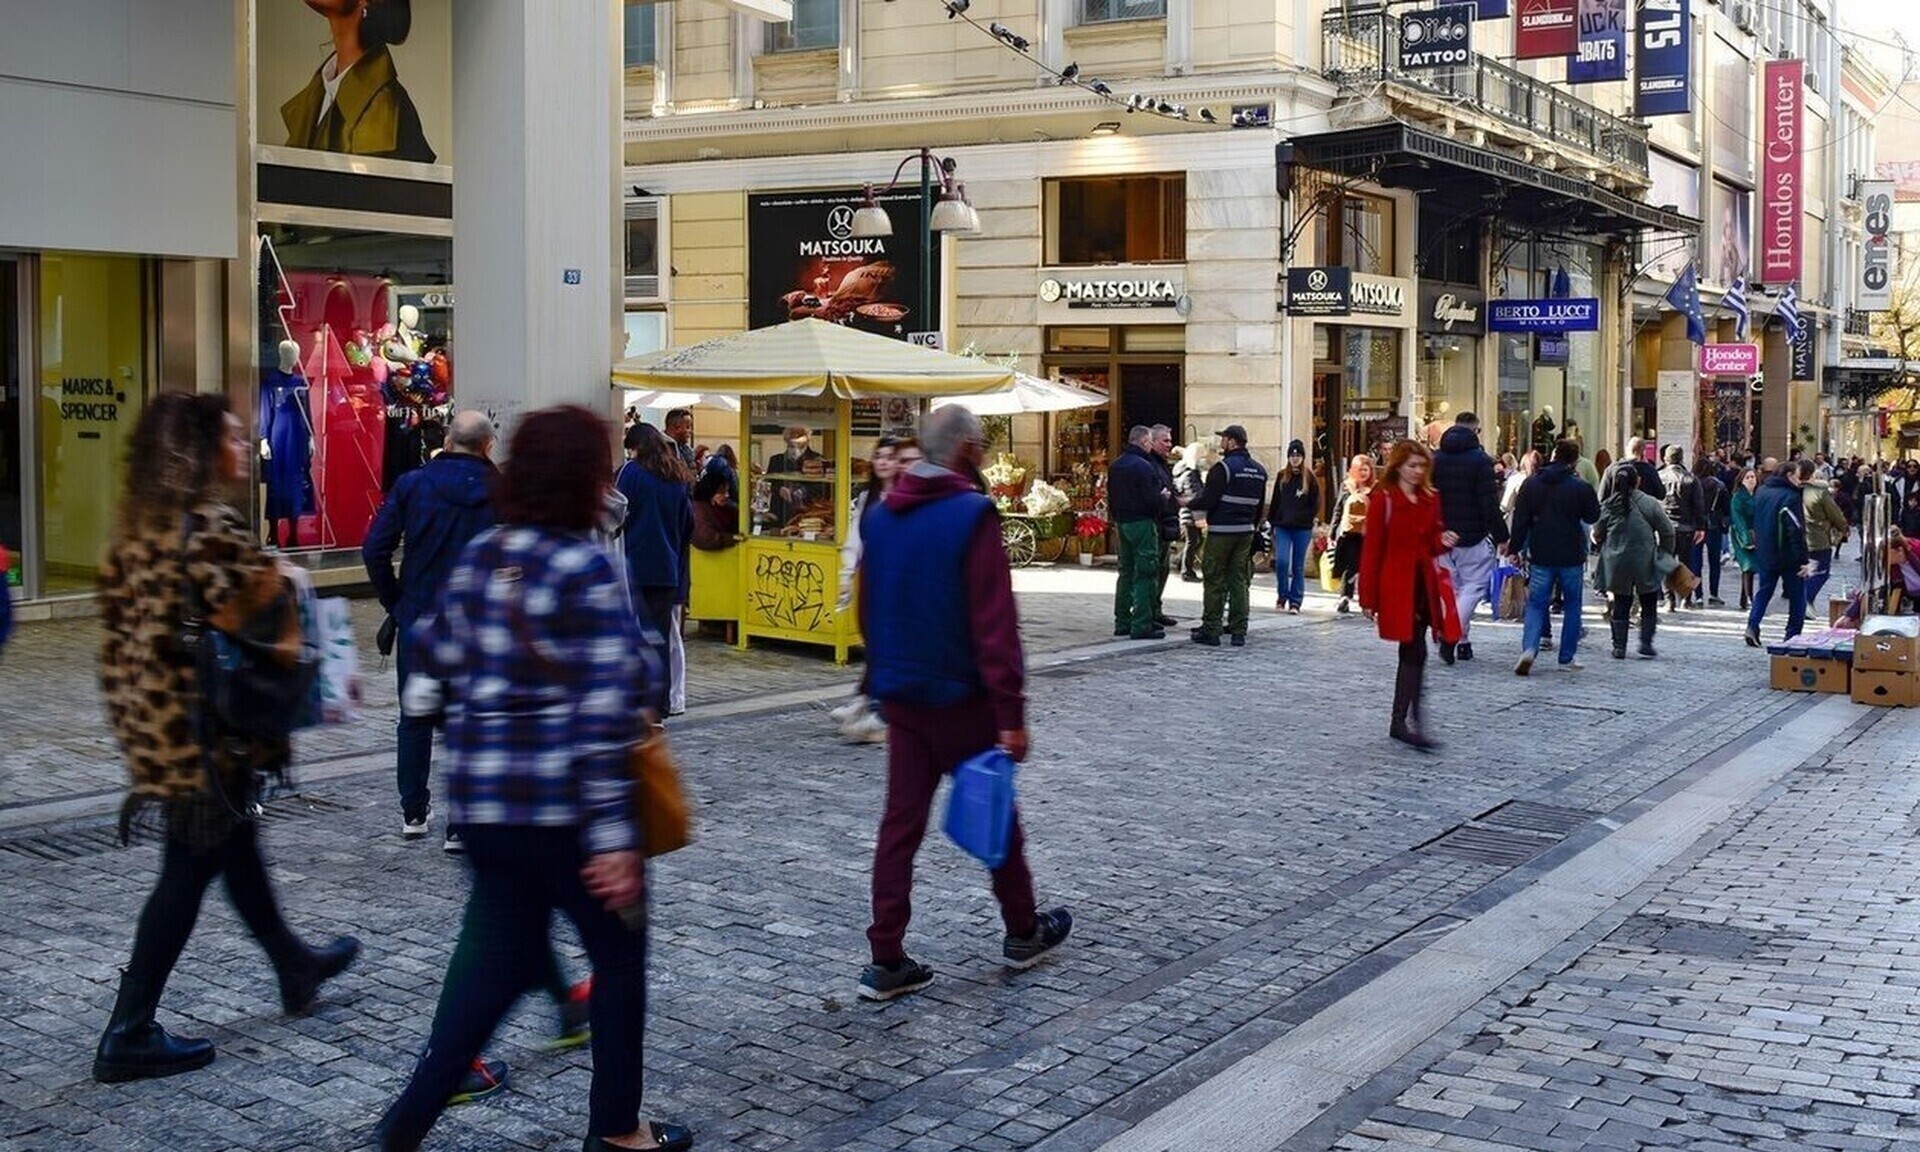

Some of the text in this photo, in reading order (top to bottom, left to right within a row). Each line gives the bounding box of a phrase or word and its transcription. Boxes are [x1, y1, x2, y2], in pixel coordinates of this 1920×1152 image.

[1402, 49, 1467, 66] TATTOO
[1576, 39, 1616, 62] NBA75
[1767, 75, 1795, 269] Hondos Center
[800, 239, 885, 256] MATSOUKA
[1067, 280, 1175, 298] MATSOUKA
[1292, 292, 1343, 301] MATSOUKA
[1351, 281, 1405, 307] MATSOUKA
[1495, 304, 1591, 317] BERTO LUCCI
[913, 334, 936, 346] WC
[1795, 317, 1808, 376] MANGO
[1706, 348, 1752, 360] Hondos
[1705, 359, 1747, 371] Center
[62, 378, 114, 395] MARKS &
[61, 402, 118, 421] SPENCER
